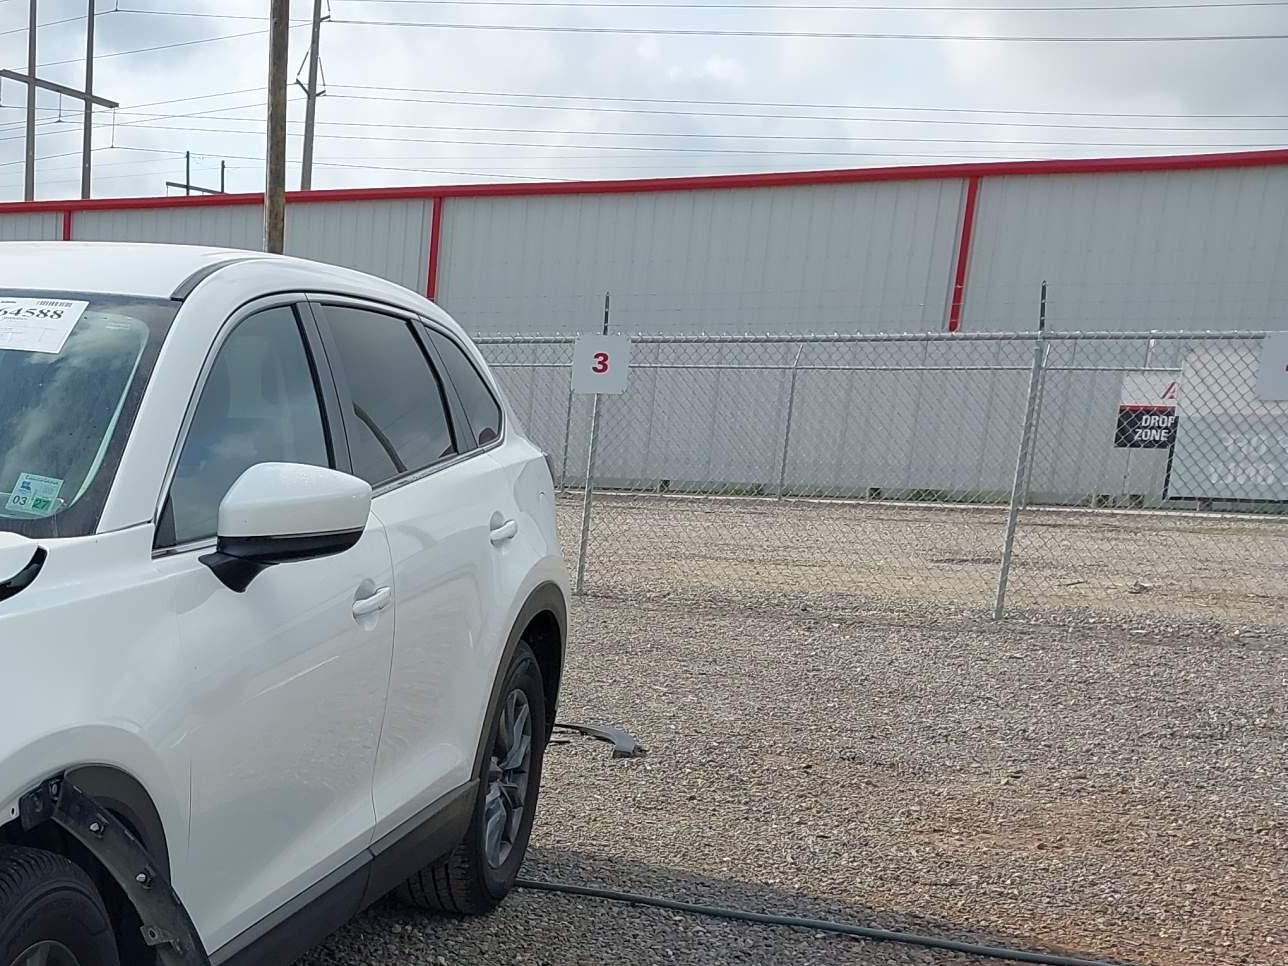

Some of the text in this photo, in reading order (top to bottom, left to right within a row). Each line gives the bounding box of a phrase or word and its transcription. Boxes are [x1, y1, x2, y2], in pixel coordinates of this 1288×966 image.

[592, 352, 609, 373] 3
[1141, 415, 1176, 427] DROP
[1134, 429, 1169, 441] ZONE
[13, 495, 50, 509] 03 27
